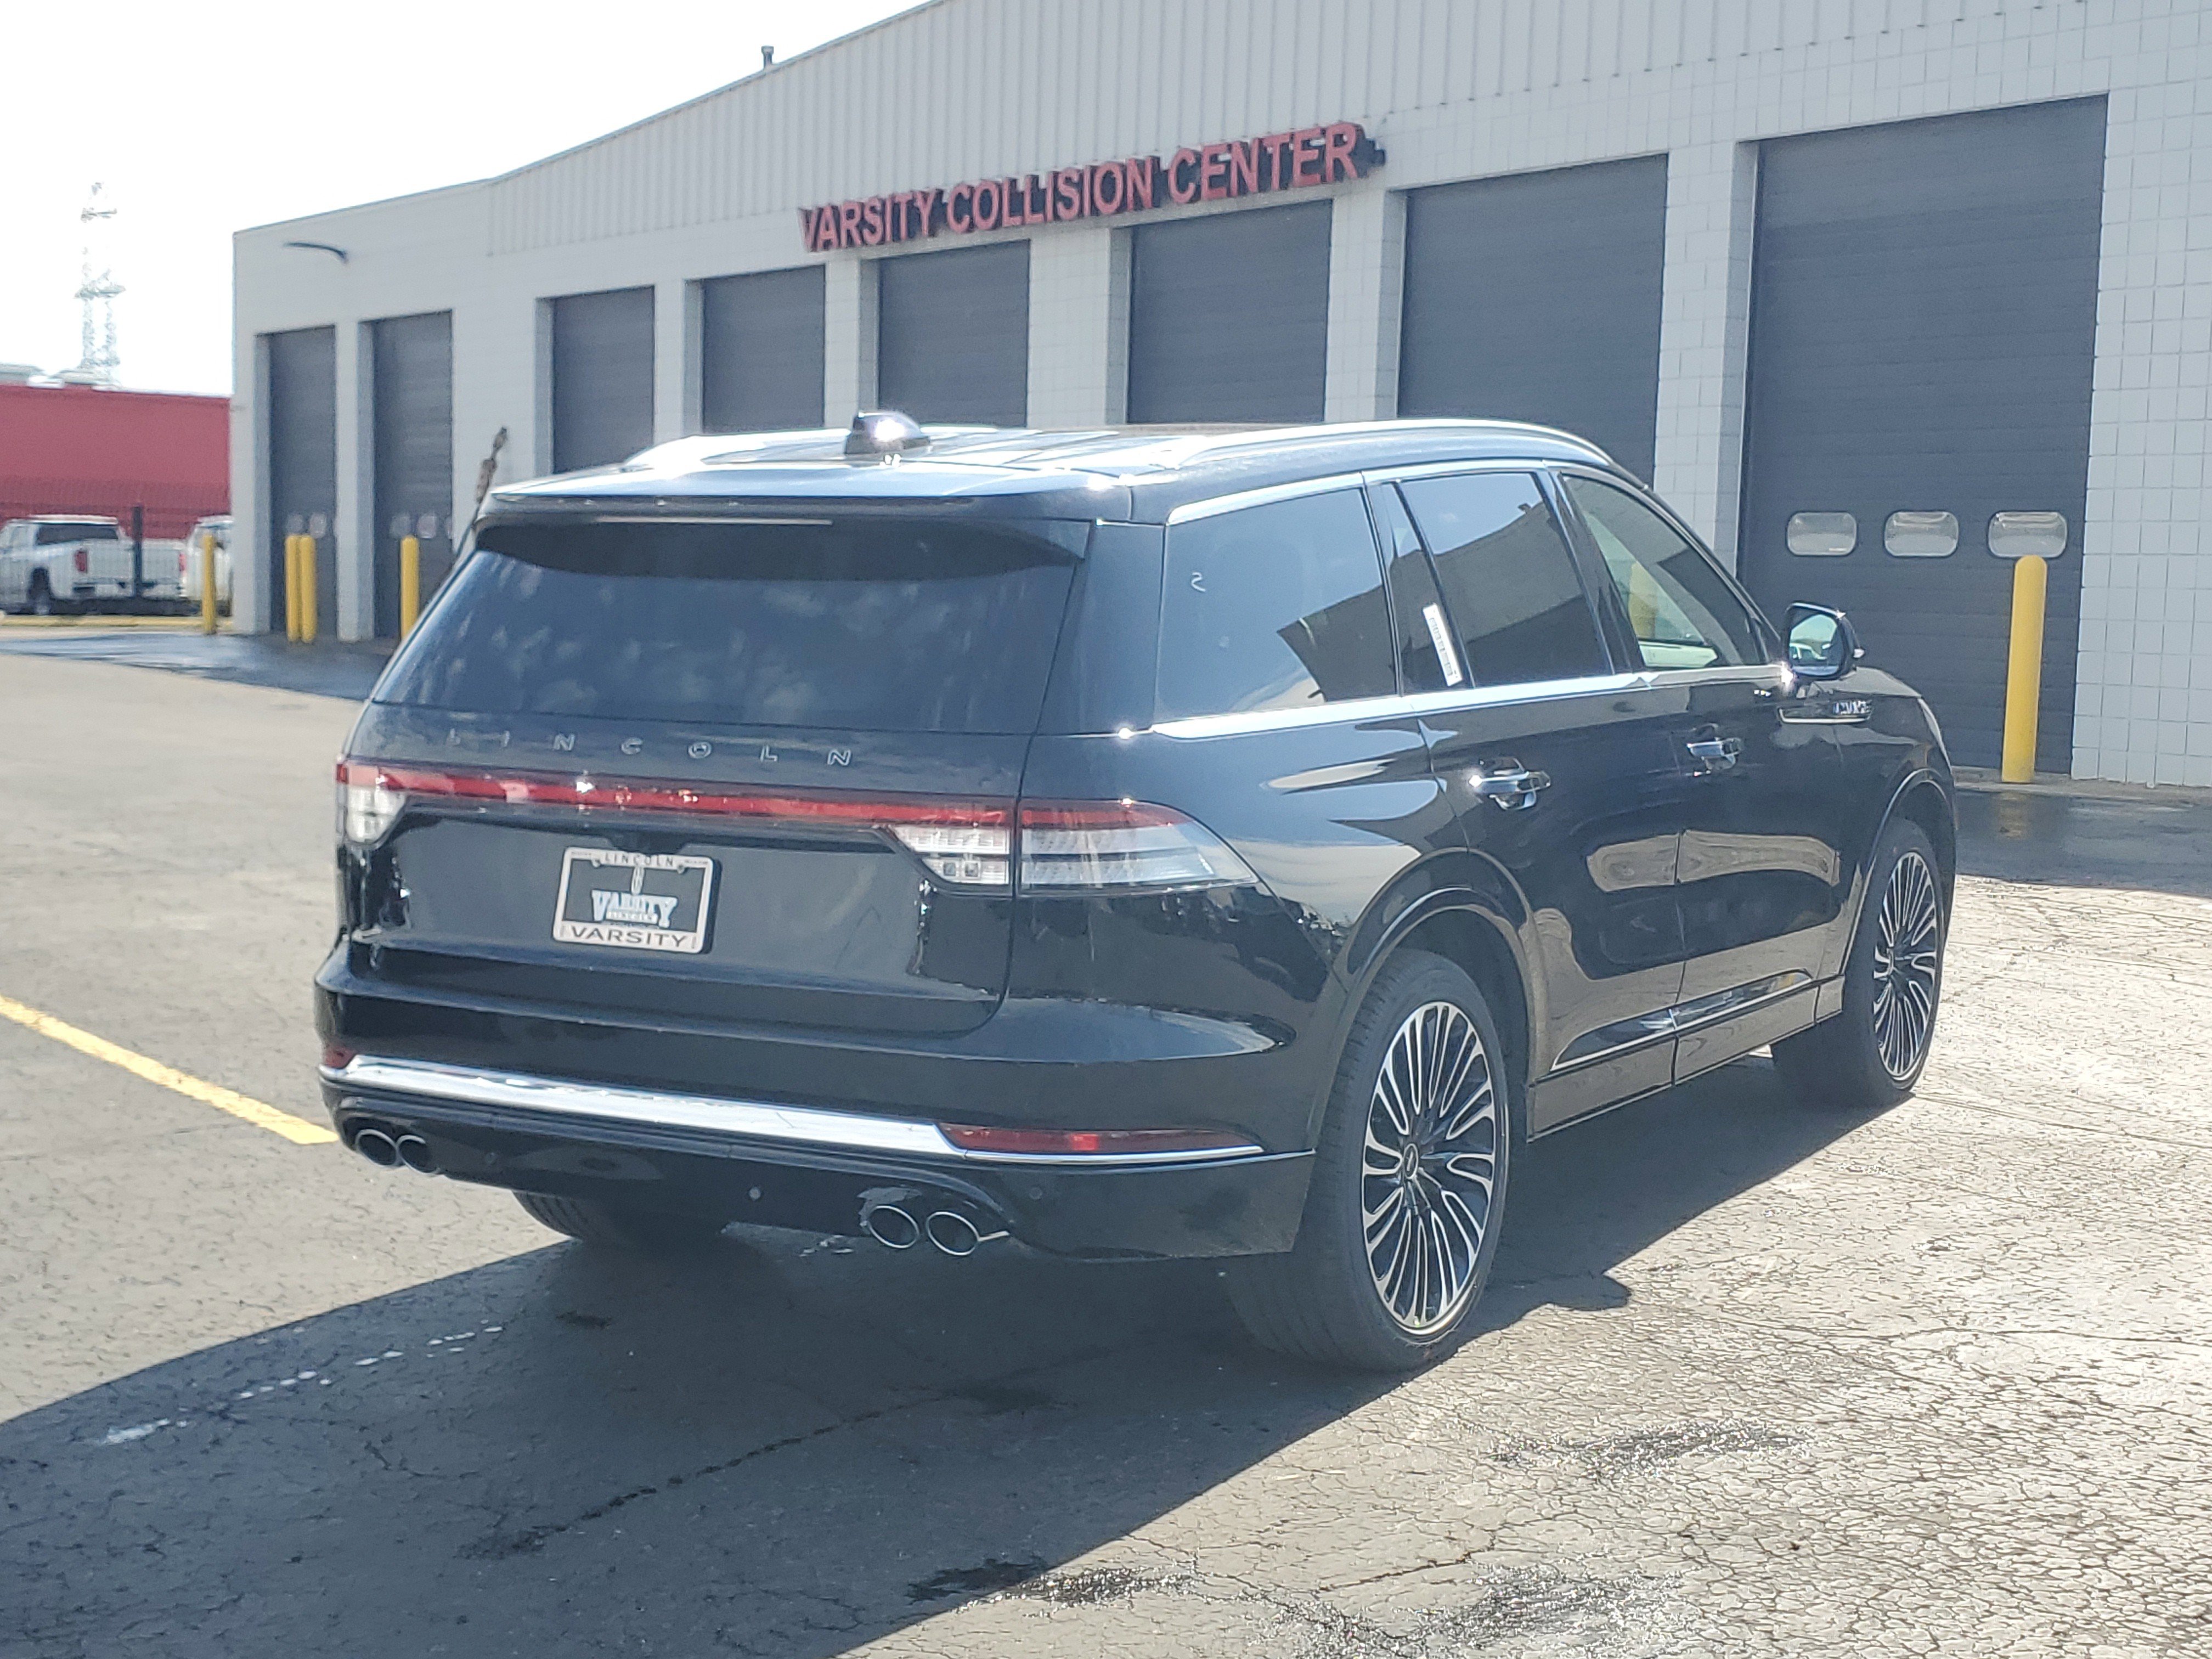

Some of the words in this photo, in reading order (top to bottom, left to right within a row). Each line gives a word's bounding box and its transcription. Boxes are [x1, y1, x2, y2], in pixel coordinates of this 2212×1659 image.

[798, 189, 939, 252] VARSITY
[946, 156, 1158, 234] COLLISION
[1167, 122, 1363, 203] CENTER
[447, 729, 852, 765] LINCOLN
[605, 854, 674, 867] LINCOLN
[571, 926, 686, 947] VARSITY
